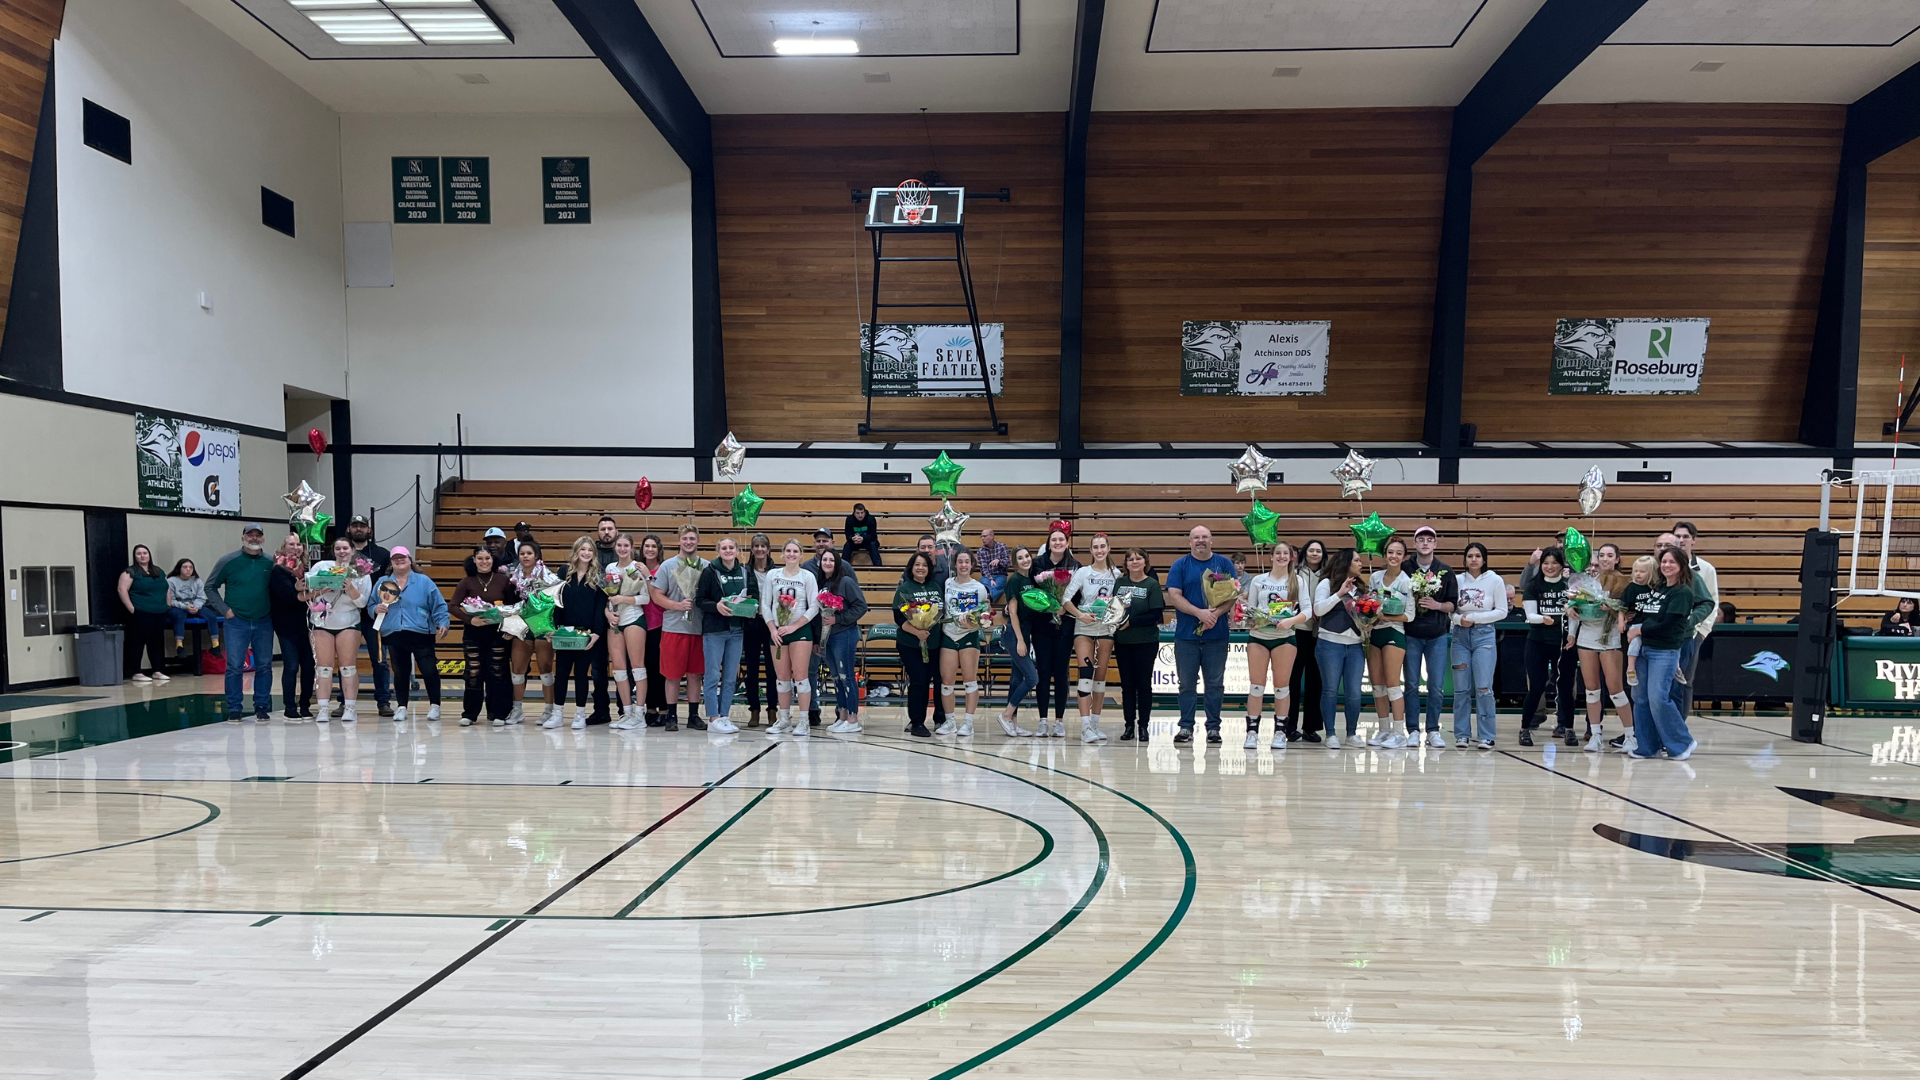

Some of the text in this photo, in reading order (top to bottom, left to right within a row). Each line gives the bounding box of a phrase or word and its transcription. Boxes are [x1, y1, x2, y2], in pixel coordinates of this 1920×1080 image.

[407, 211, 428, 219] 2020
[457, 211, 477, 219] 2020
[557, 211, 576, 219] 2021
[1268, 334, 1299, 344] Alexis
[1254, 349, 1312, 357] Atchinson DDS
[1614, 359, 1698, 378] Roseburg
[207, 442, 236, 463] pepsi
[147, 480, 175, 489] ATHLETICS
[203, 475, 220, 507] G
